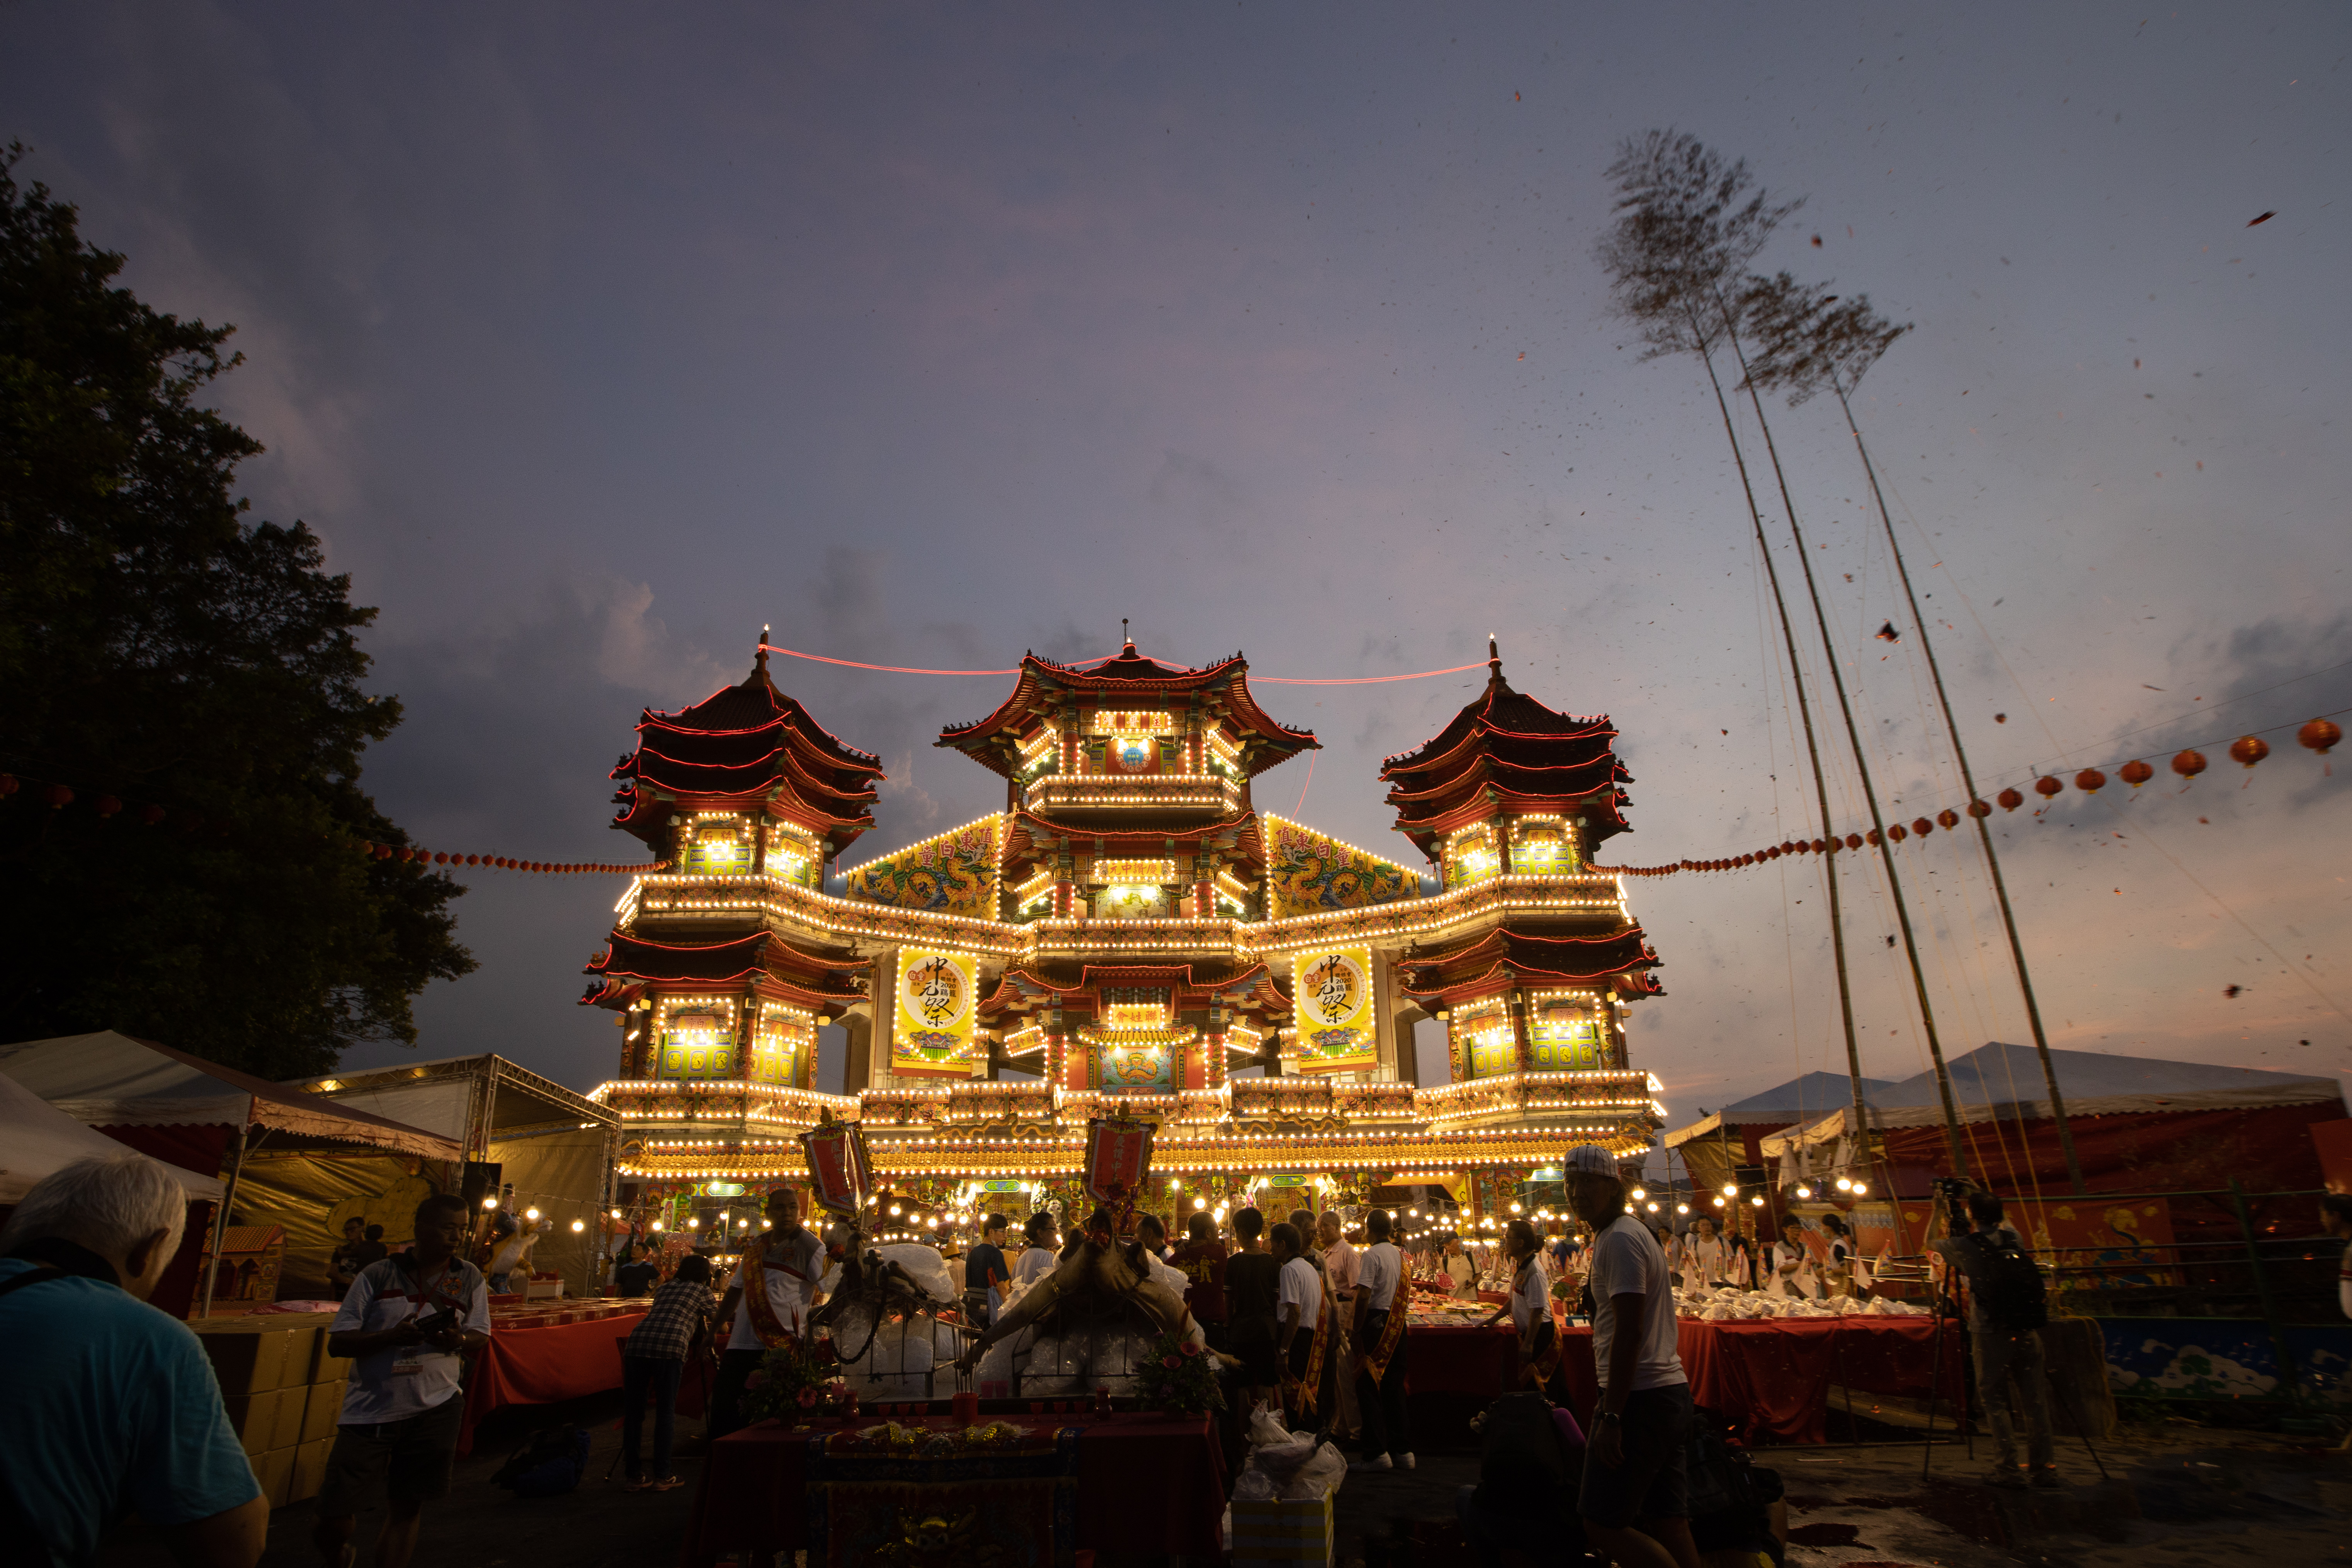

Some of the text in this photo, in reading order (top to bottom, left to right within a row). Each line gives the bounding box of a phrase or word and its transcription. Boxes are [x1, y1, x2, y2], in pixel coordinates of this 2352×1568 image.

[1103, 715, 1162, 727] 主普壇
[1275, 826, 1352, 867] 值東白童
[1109, 862, 1159, 876] 慶讚中元
[909, 971, 925, 981] 白童
[1305, 973, 1320, 982] 白童
[919, 956, 954, 1027] 中元祭
[1316, 955, 1352, 1024] 中元祭
[1115, 1010, 1157, 1023] 聯姓會
